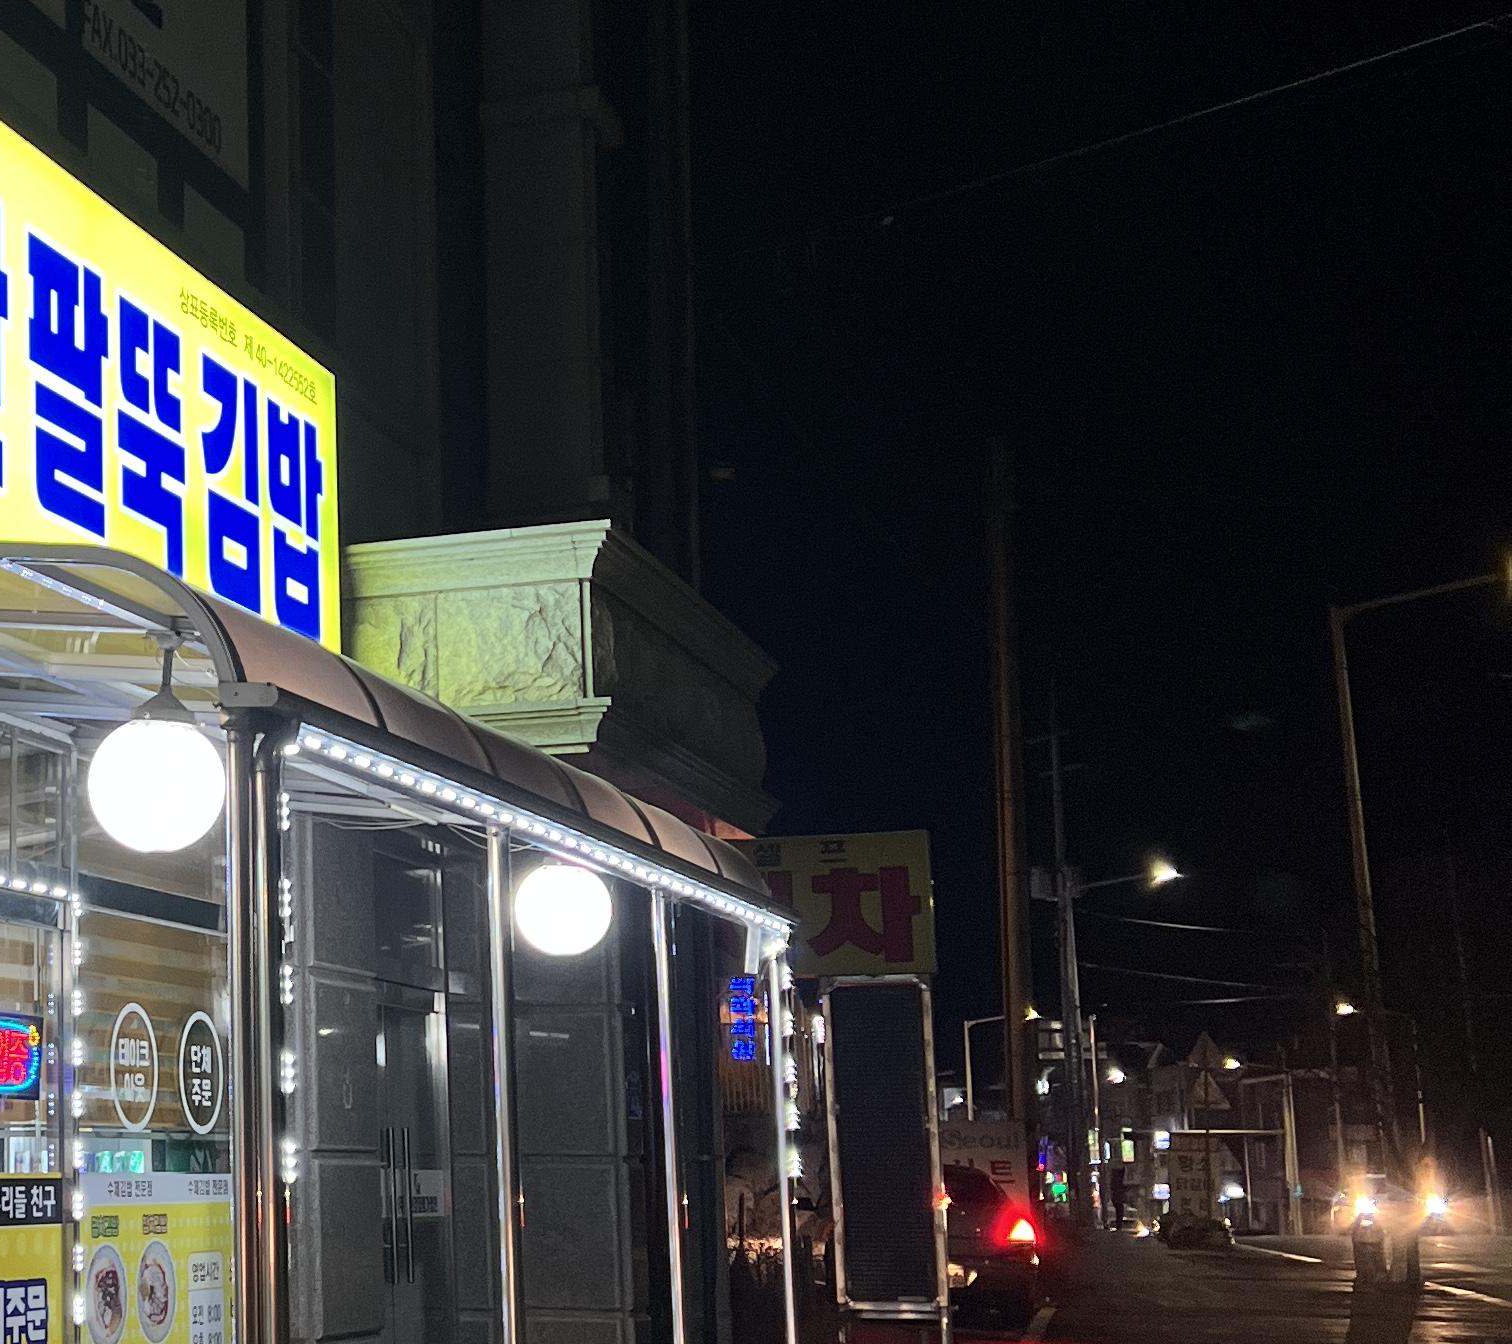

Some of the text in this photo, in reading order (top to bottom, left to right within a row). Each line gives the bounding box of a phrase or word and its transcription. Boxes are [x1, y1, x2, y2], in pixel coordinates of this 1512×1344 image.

[179, 286, 238, 348] 상표등록번호
[244, 334, 254, 361] 제
[201, 352, 324, 642] 김밥
[30, 1185, 57, 1219] 친구
